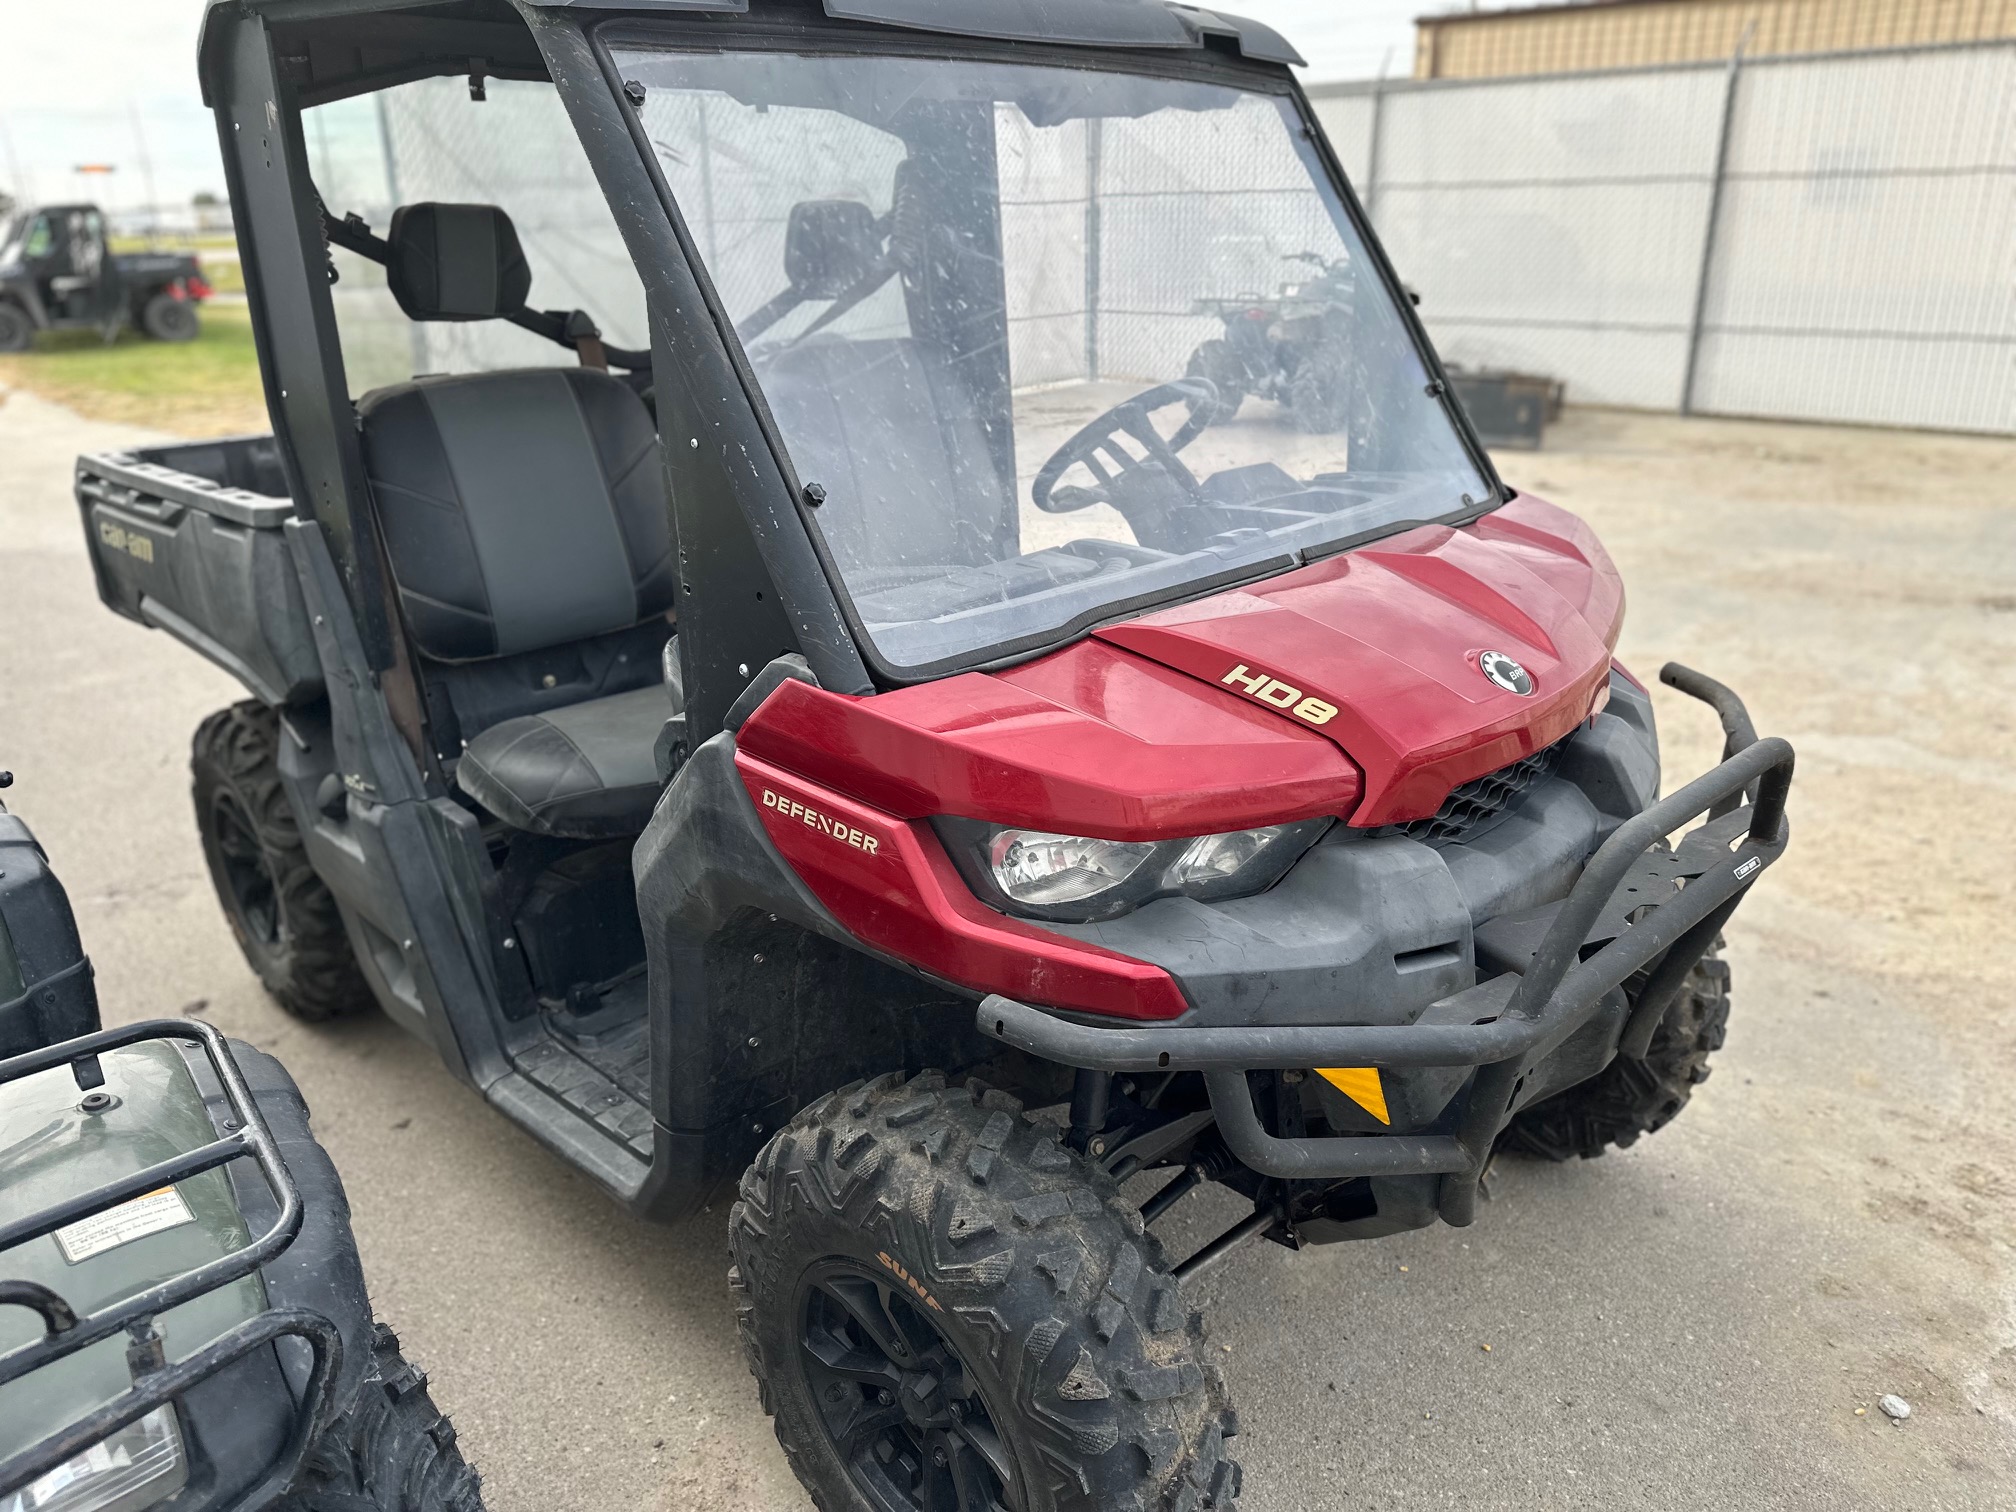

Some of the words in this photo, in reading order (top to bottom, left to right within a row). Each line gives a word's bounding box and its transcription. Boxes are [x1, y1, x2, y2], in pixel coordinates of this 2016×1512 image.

[1221, 664, 1339, 725] HD8
[1509, 667, 1524, 681] BRP
[762, 789, 879, 855] DEFENDER
